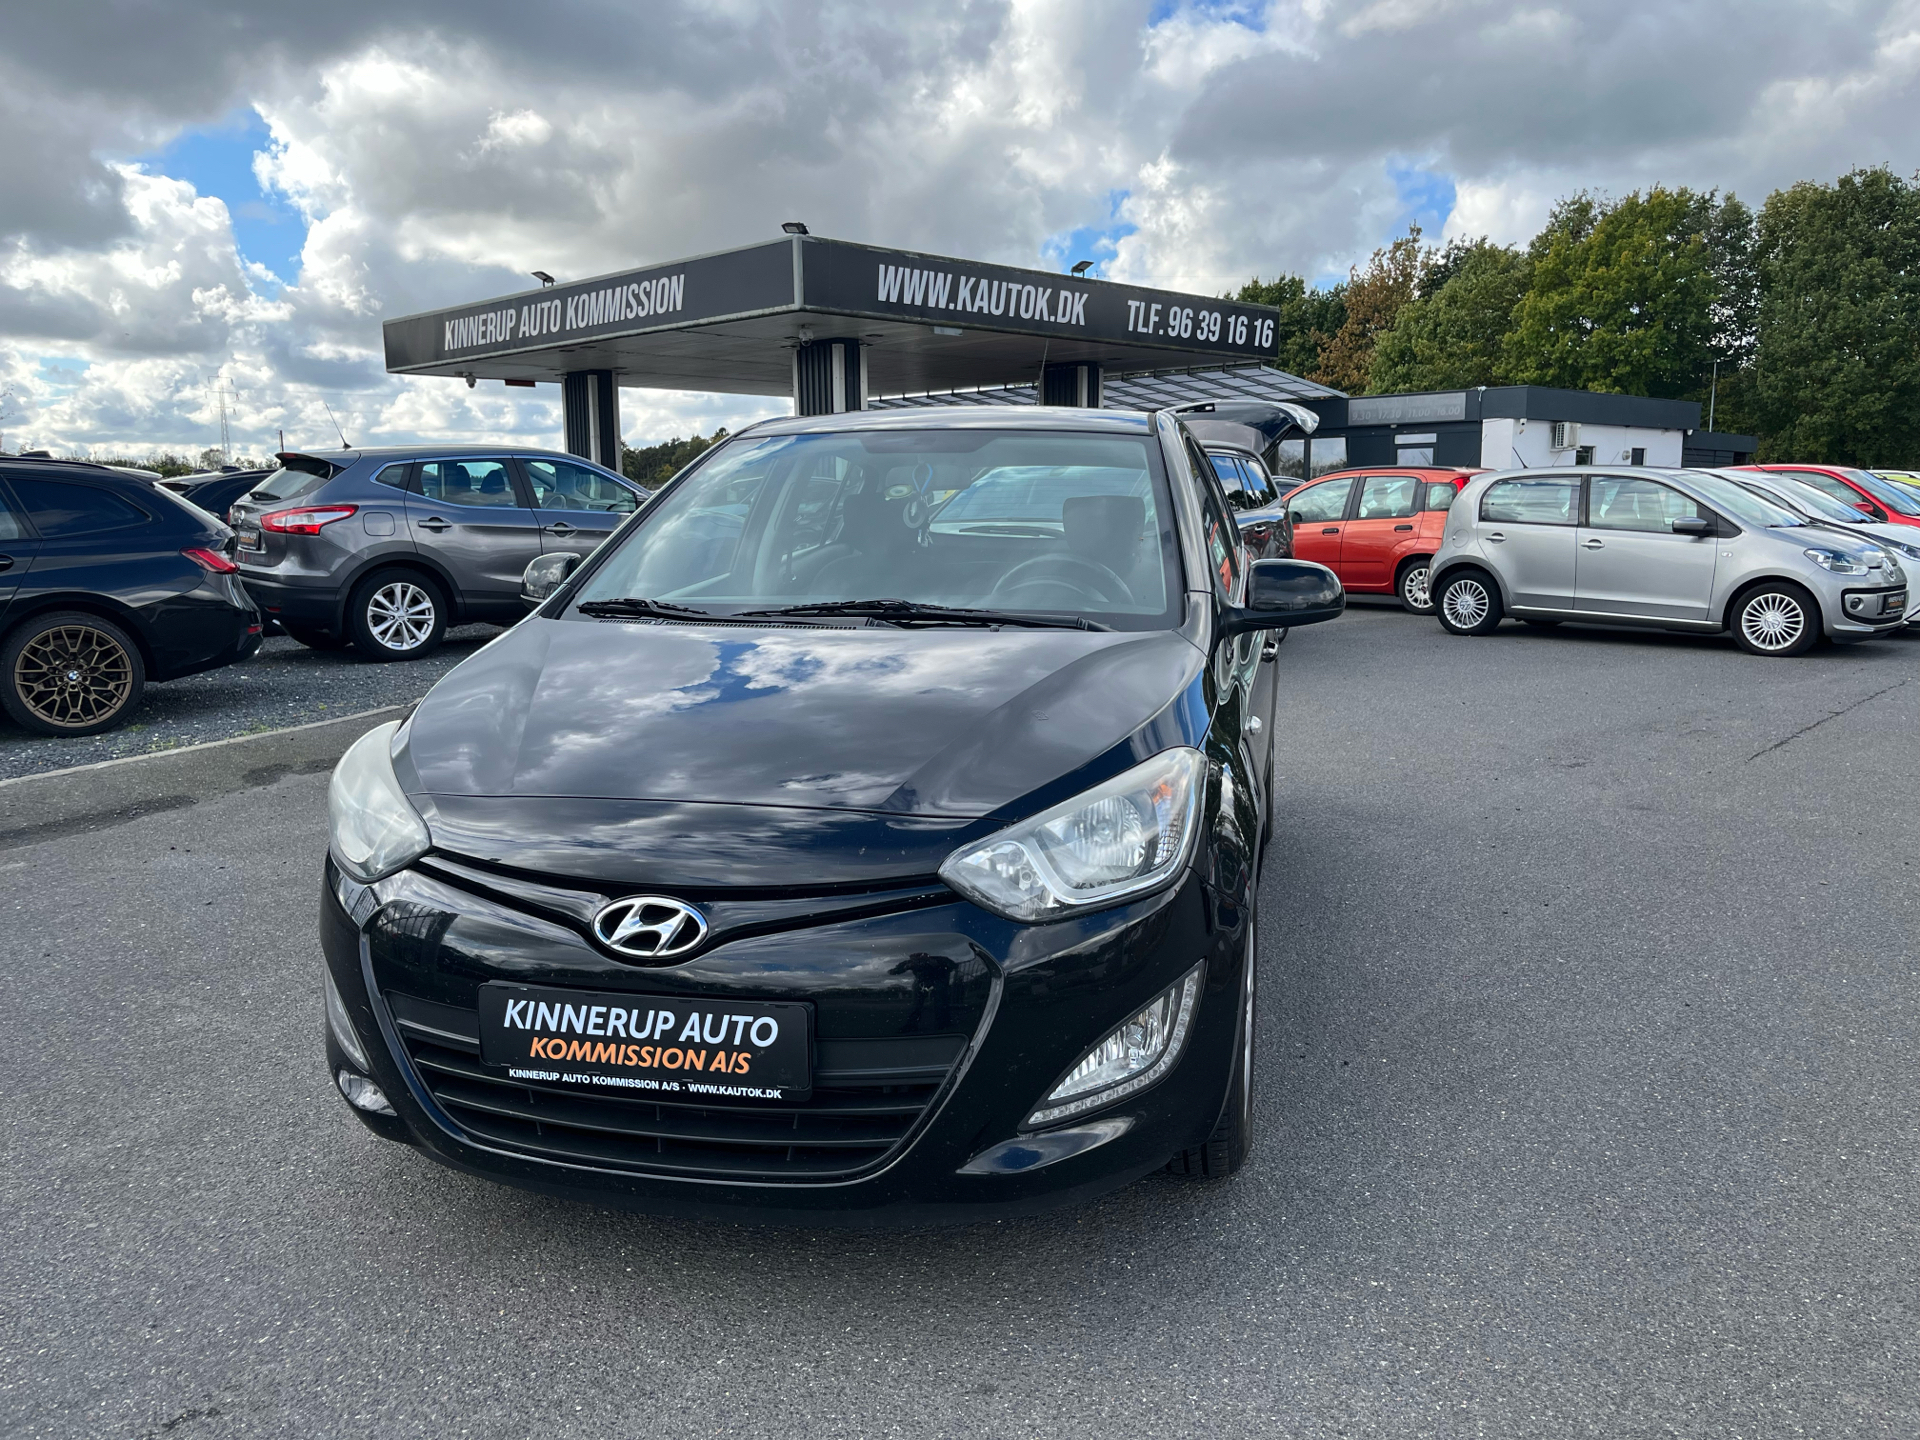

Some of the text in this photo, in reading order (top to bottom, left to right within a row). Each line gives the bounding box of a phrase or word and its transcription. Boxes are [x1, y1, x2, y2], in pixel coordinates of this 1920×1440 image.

[444, 273, 686, 351] KINNERUP AUTO KOMMISSION
[877, 264, 1275, 348] WWW.KAUTOK.DK TLF. 96 39 16 16
[503, 998, 779, 1048] KINNERUP AUTO
[529, 1036, 752, 1075] KOMMISSION A/S
[508, 1068, 560, 1081] KINNERUP
[562, 1073, 590, 1084] AUTO
[592, 1076, 660, 1091] KOMMISSION
[661, 1082, 680, 1092] A/S
[687, 1083, 782, 1099] WWW.KAUTOK.DK
